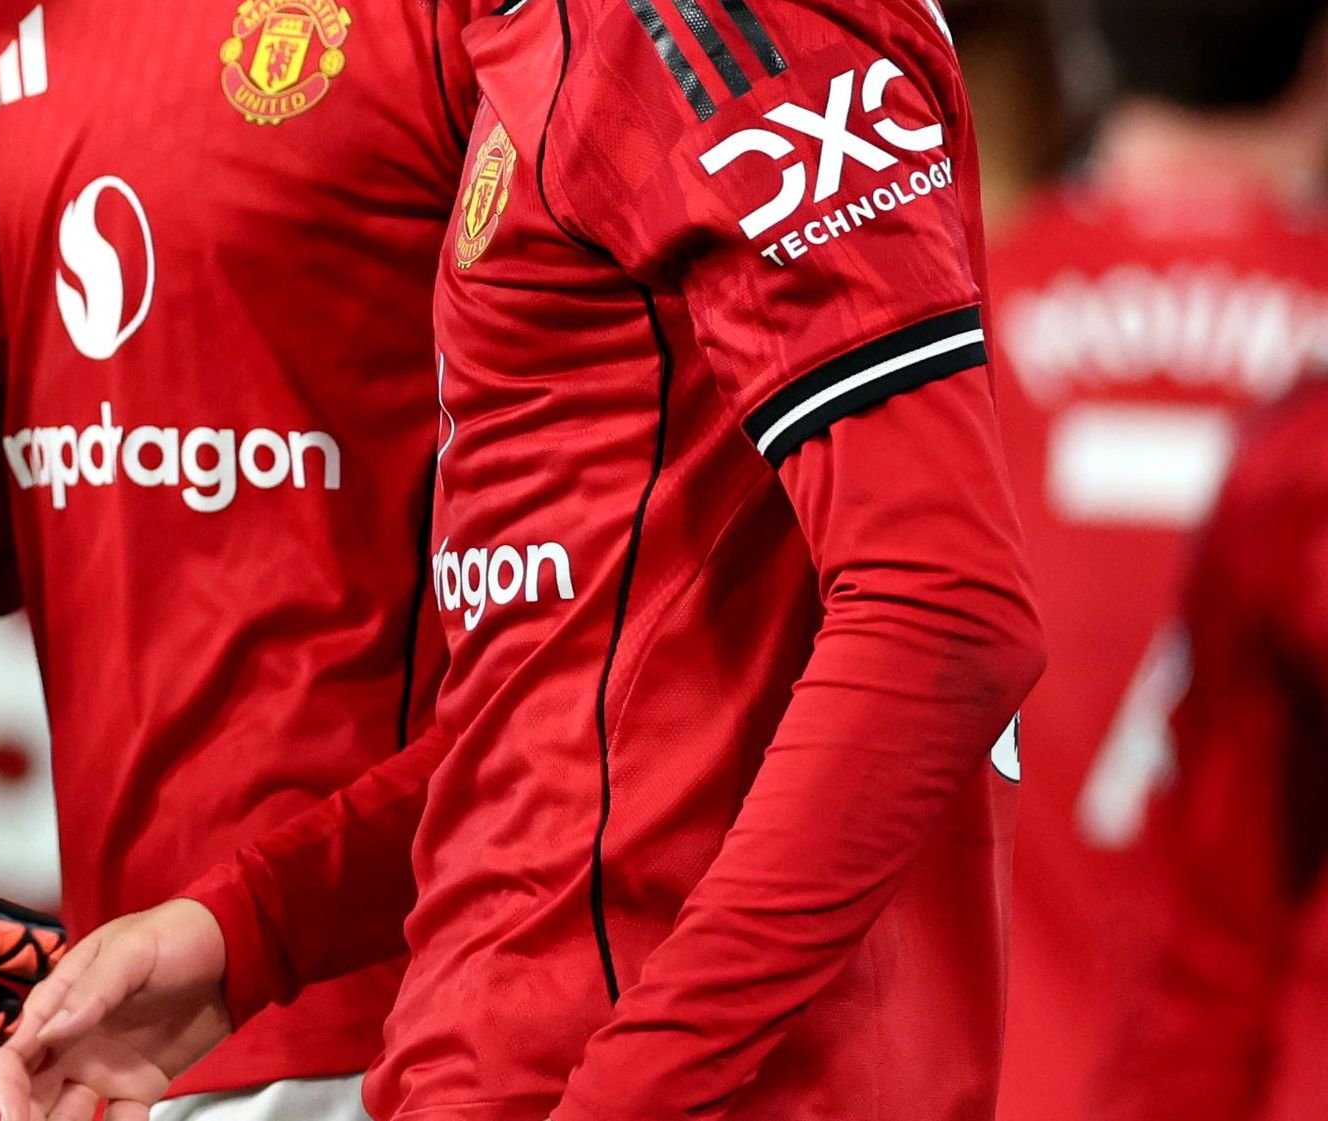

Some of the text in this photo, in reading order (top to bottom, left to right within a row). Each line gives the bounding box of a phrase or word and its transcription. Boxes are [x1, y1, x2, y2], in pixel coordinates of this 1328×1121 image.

[234, 84, 306, 114] UNITED
[698, 57, 944, 241] DXC
[760, 157, 953, 267] TECHNOLOGY
[2, 400, 341, 513] napdragon
